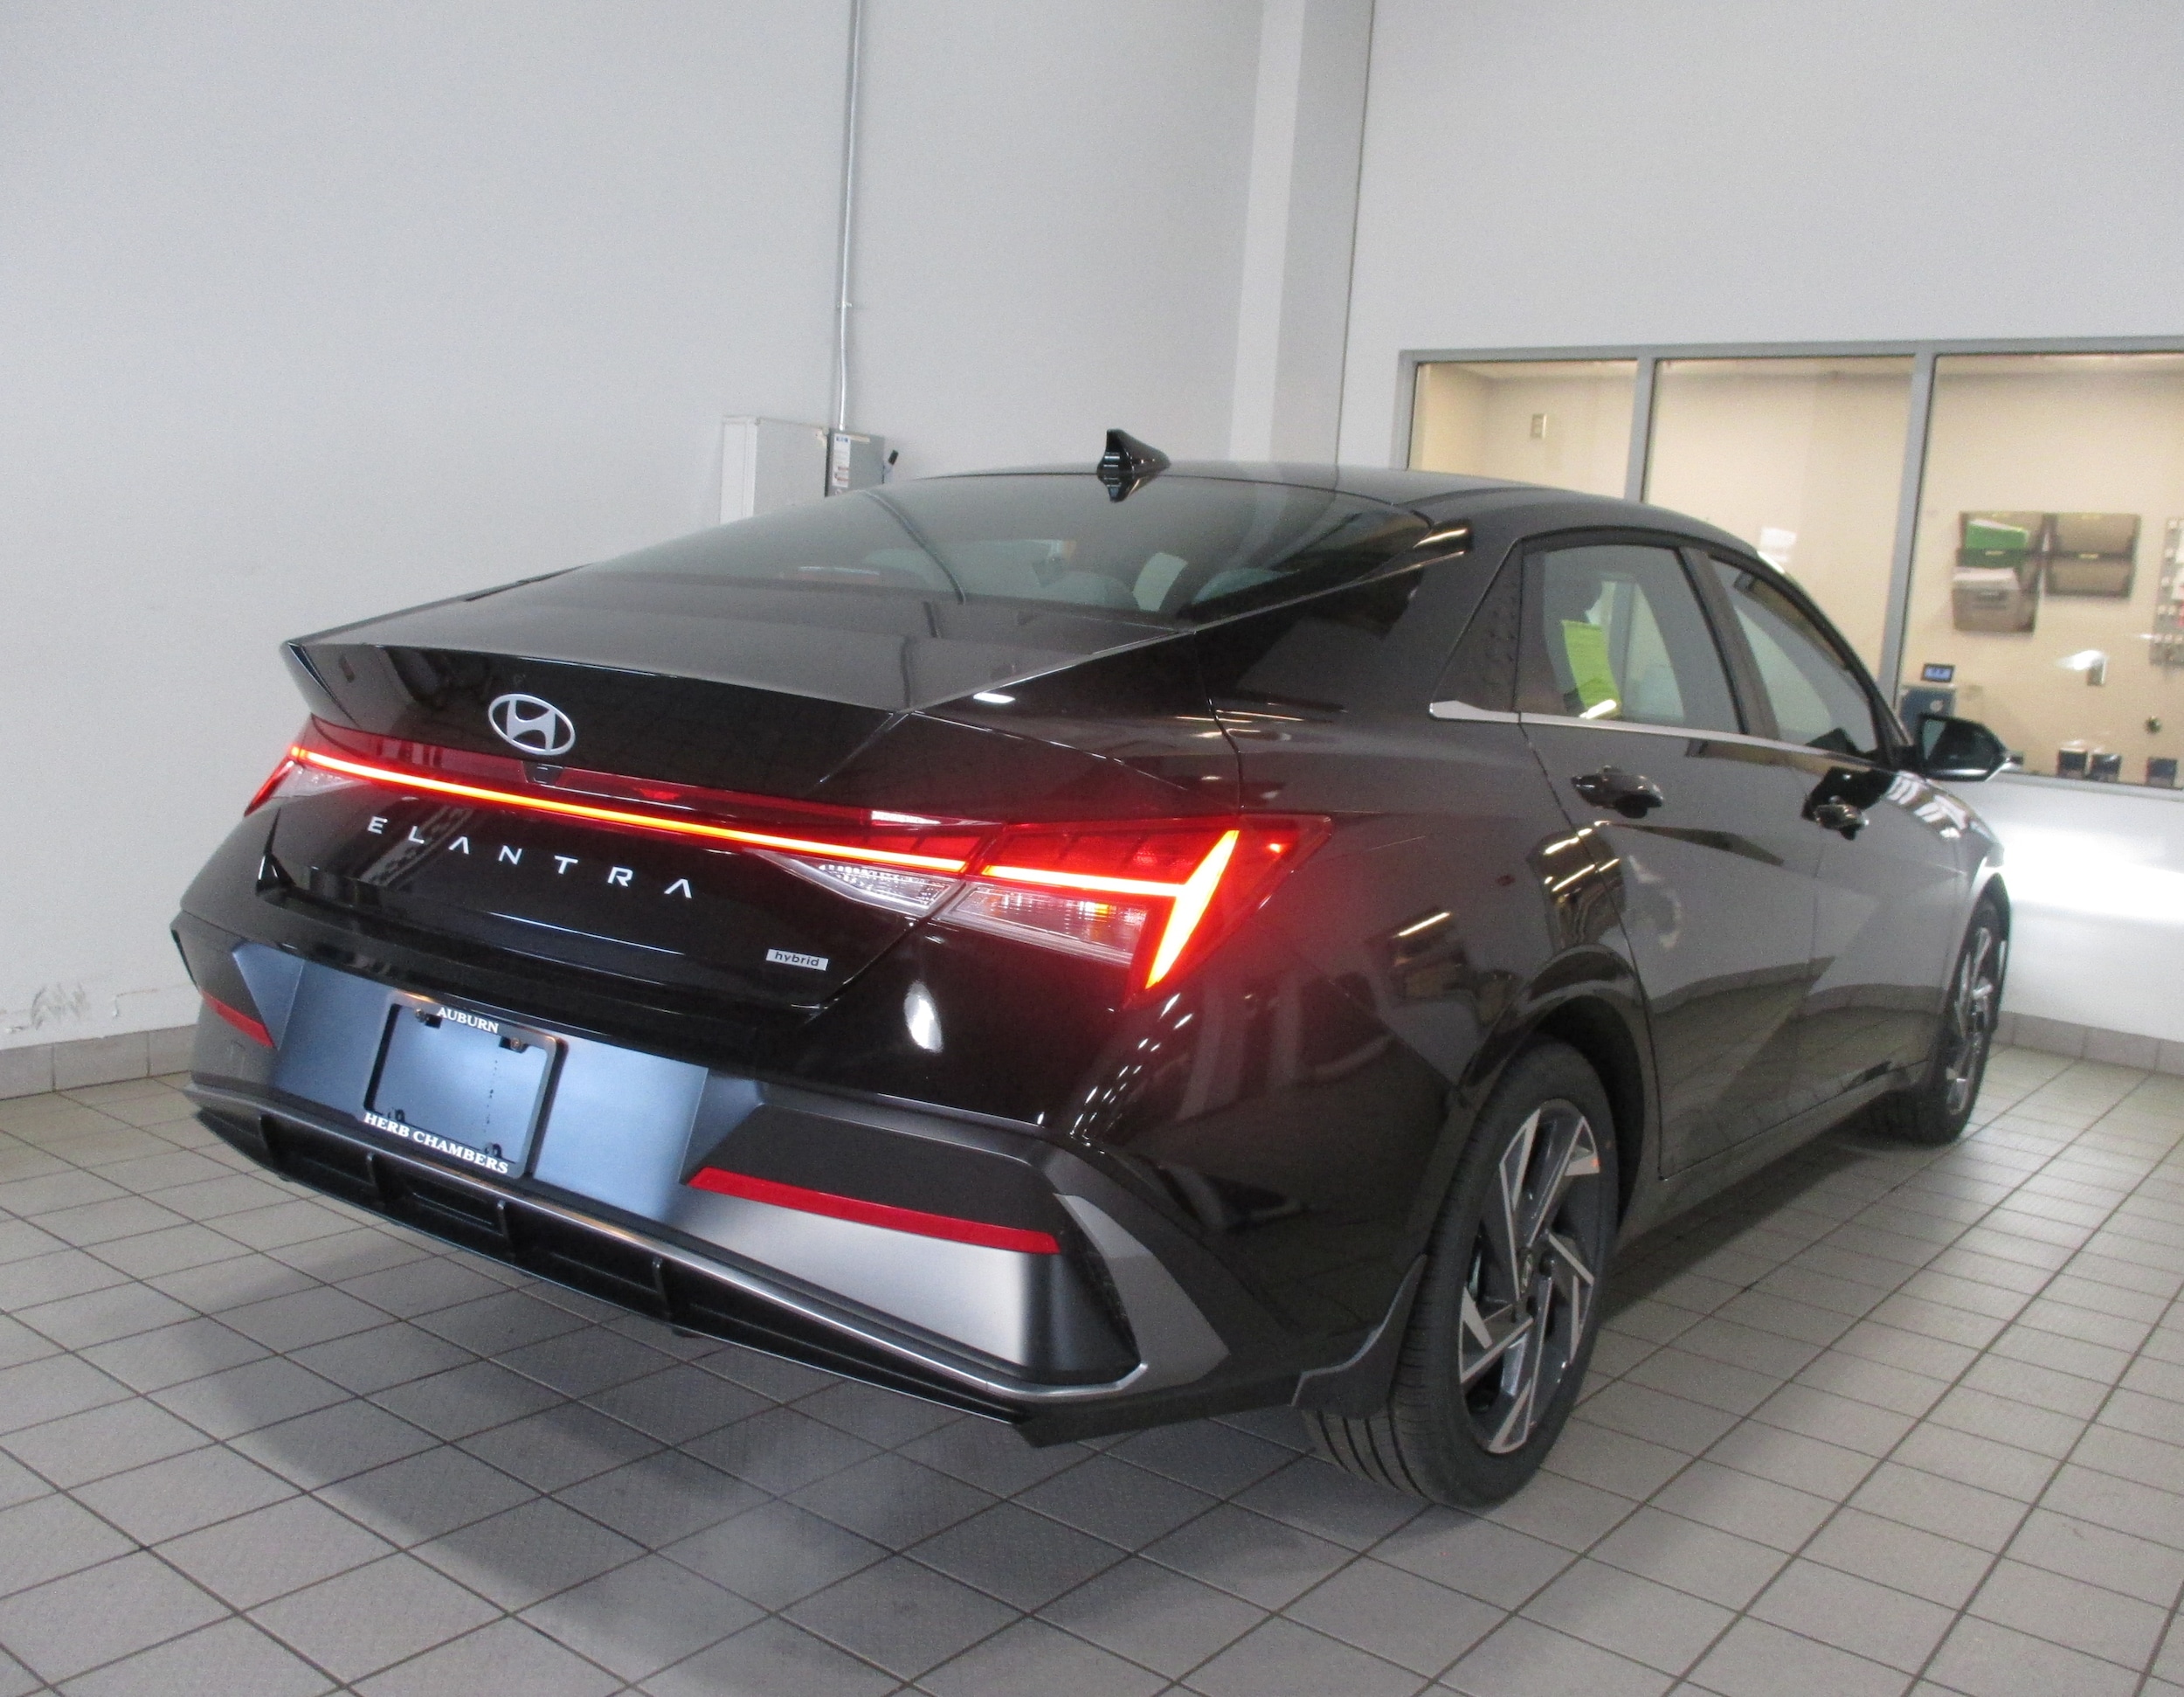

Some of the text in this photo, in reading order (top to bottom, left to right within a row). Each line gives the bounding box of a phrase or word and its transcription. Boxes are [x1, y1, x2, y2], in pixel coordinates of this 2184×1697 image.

[368, 815, 693, 899] ELANTRA
[775, 951, 819, 967] hybrid
[437, 1007, 499, 1034] AUBURN
[363, 1112, 508, 1174] HERB CHAMBERS
